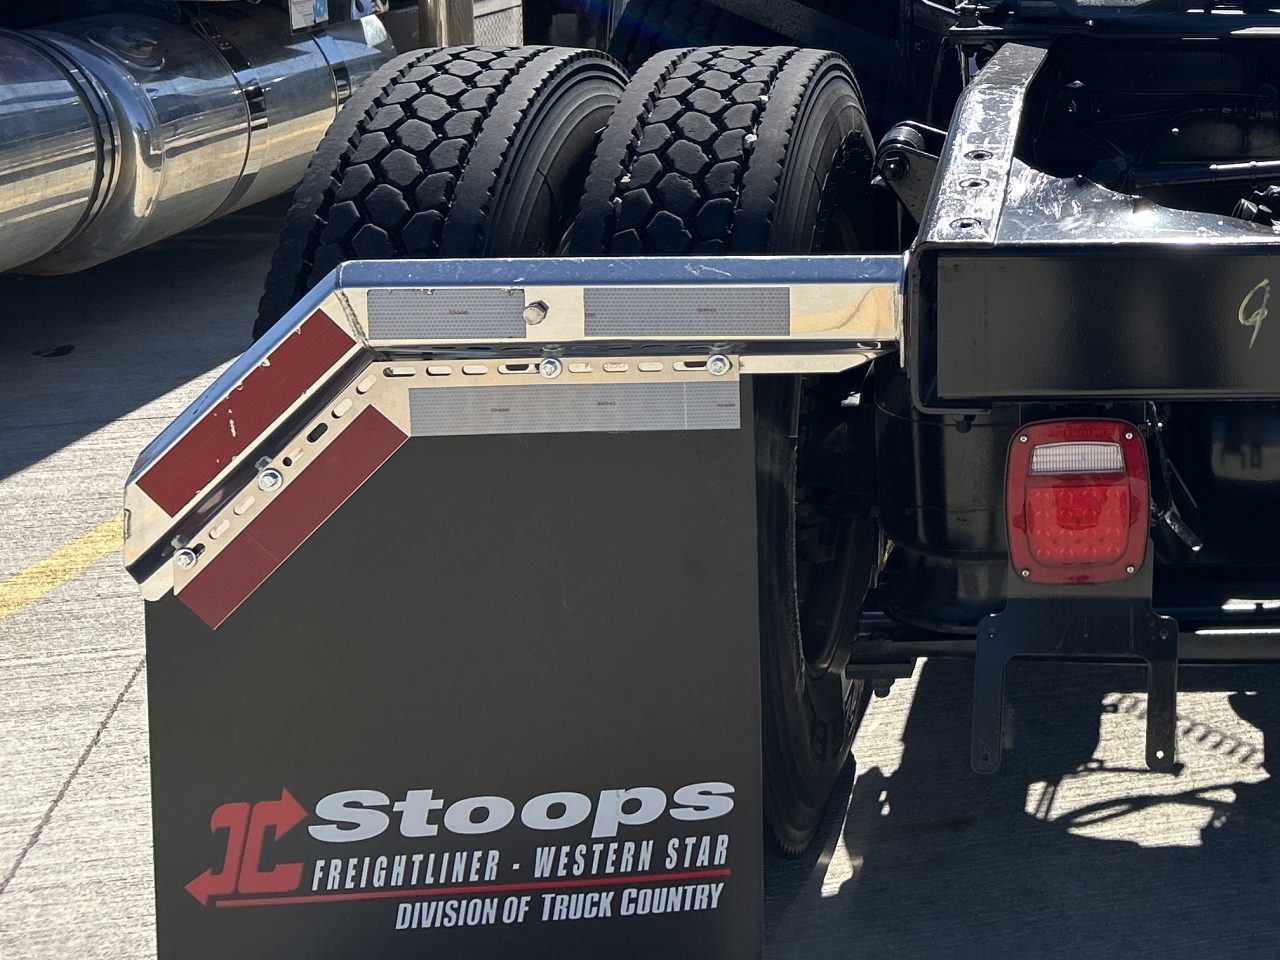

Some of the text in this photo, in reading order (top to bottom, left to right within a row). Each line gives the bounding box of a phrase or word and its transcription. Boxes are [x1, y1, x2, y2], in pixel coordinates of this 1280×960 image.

[307, 781, 735, 843] Stoops
[311, 849, 500, 891] FREIGHTLINER
[534, 839, 654, 878] WESTERN
[665, 834, 729, 870] STAR
[395, 882, 725, 930] DIVISION OF TRUCK COUNTRY
